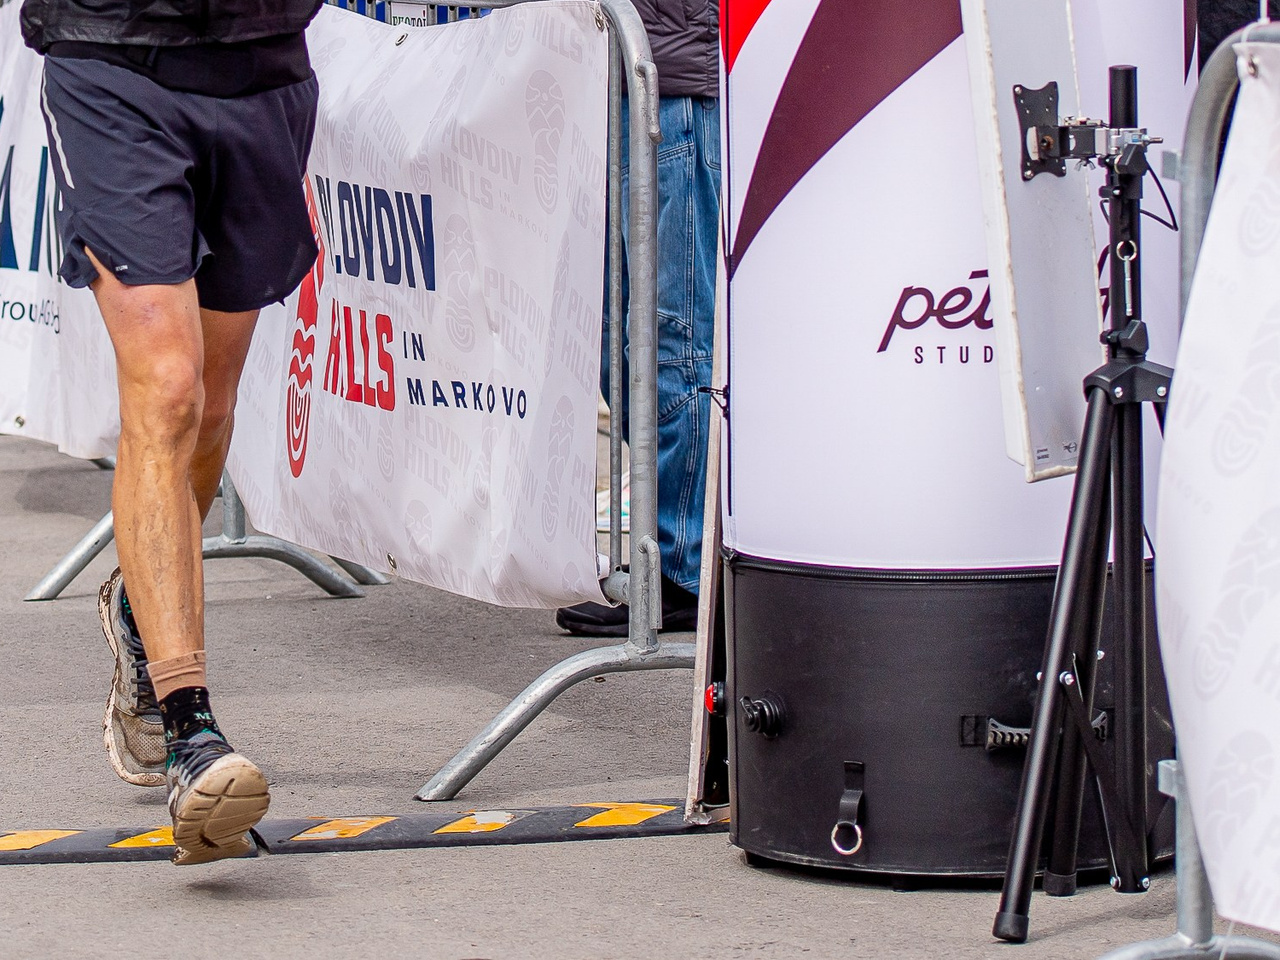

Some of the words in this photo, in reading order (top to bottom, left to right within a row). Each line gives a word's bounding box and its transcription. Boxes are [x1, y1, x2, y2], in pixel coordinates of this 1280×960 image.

[315, 175, 435, 291] PLOVDIV
[403, 331, 426, 362] IN
[914, 346, 994, 364] STUD
[406, 377, 527, 419] MARKOVO
